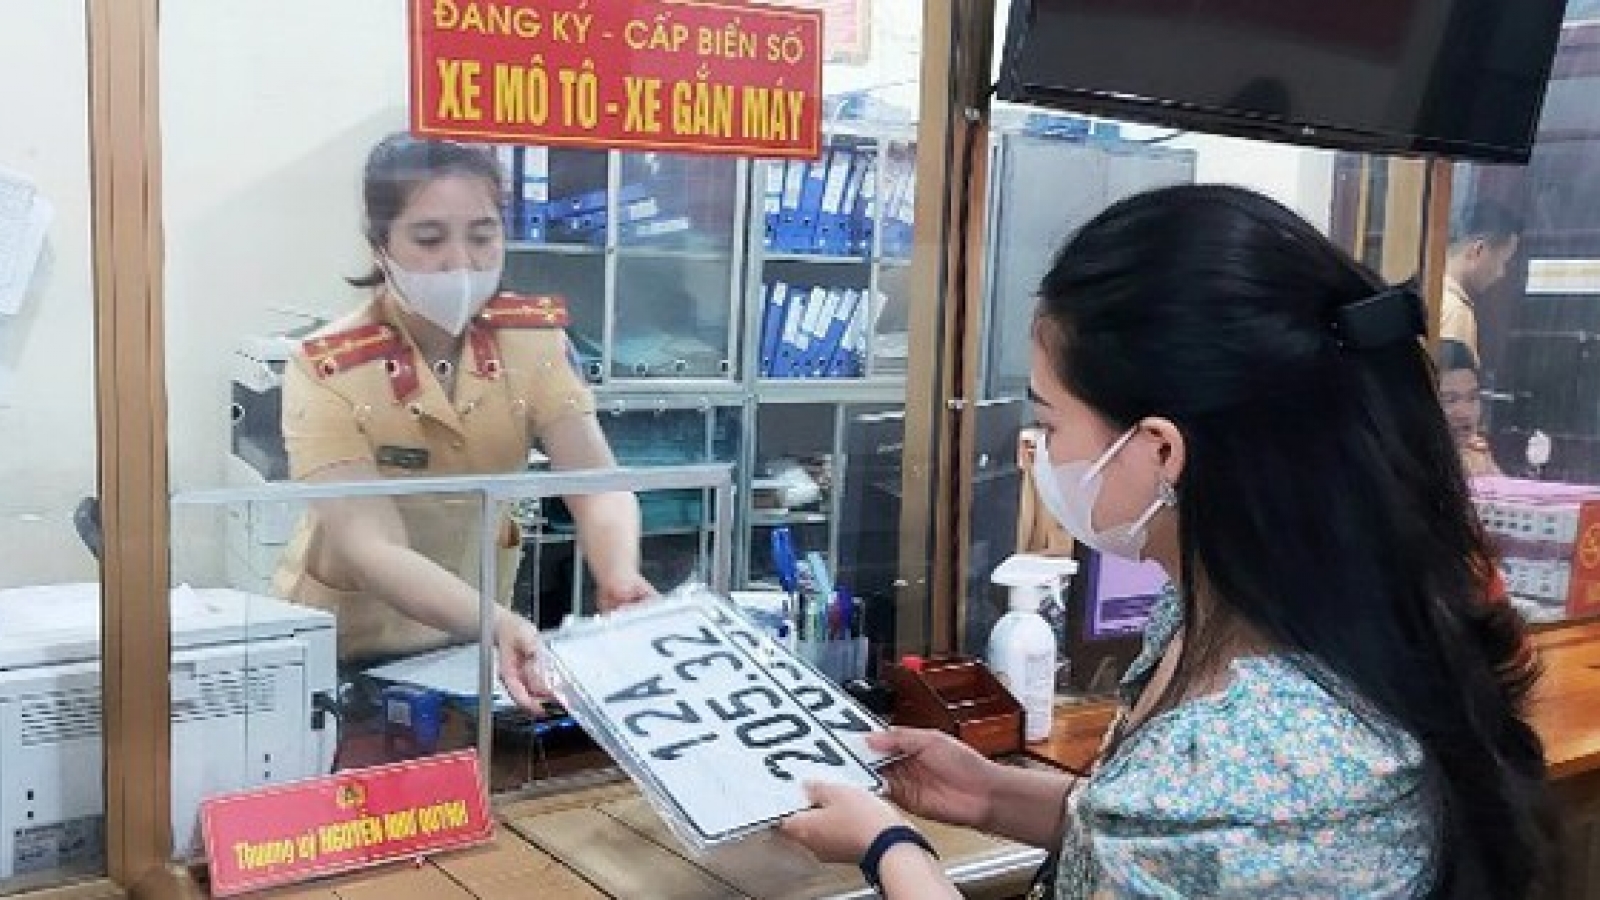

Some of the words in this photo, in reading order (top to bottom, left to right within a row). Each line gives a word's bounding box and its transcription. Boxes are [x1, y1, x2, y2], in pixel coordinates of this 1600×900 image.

[552, 0, 594, 44] KÝ
[624, 11, 689, 52] CẤP
[698, 17, 757, 58] BIỂN
[767, 27, 803, 64] SỐ
[437, 60, 482, 120] XE
[495, 54, 549, 126] MÔ
[559, 60, 598, 129] TÔ
[624, 77, 662, 133] XE
[672, 63, 734, 138] GẮN
[741, 78, 805, 141] MÁY
[604, 672, 721, 761] 12A
[652, 626, 846, 781] 205.32
